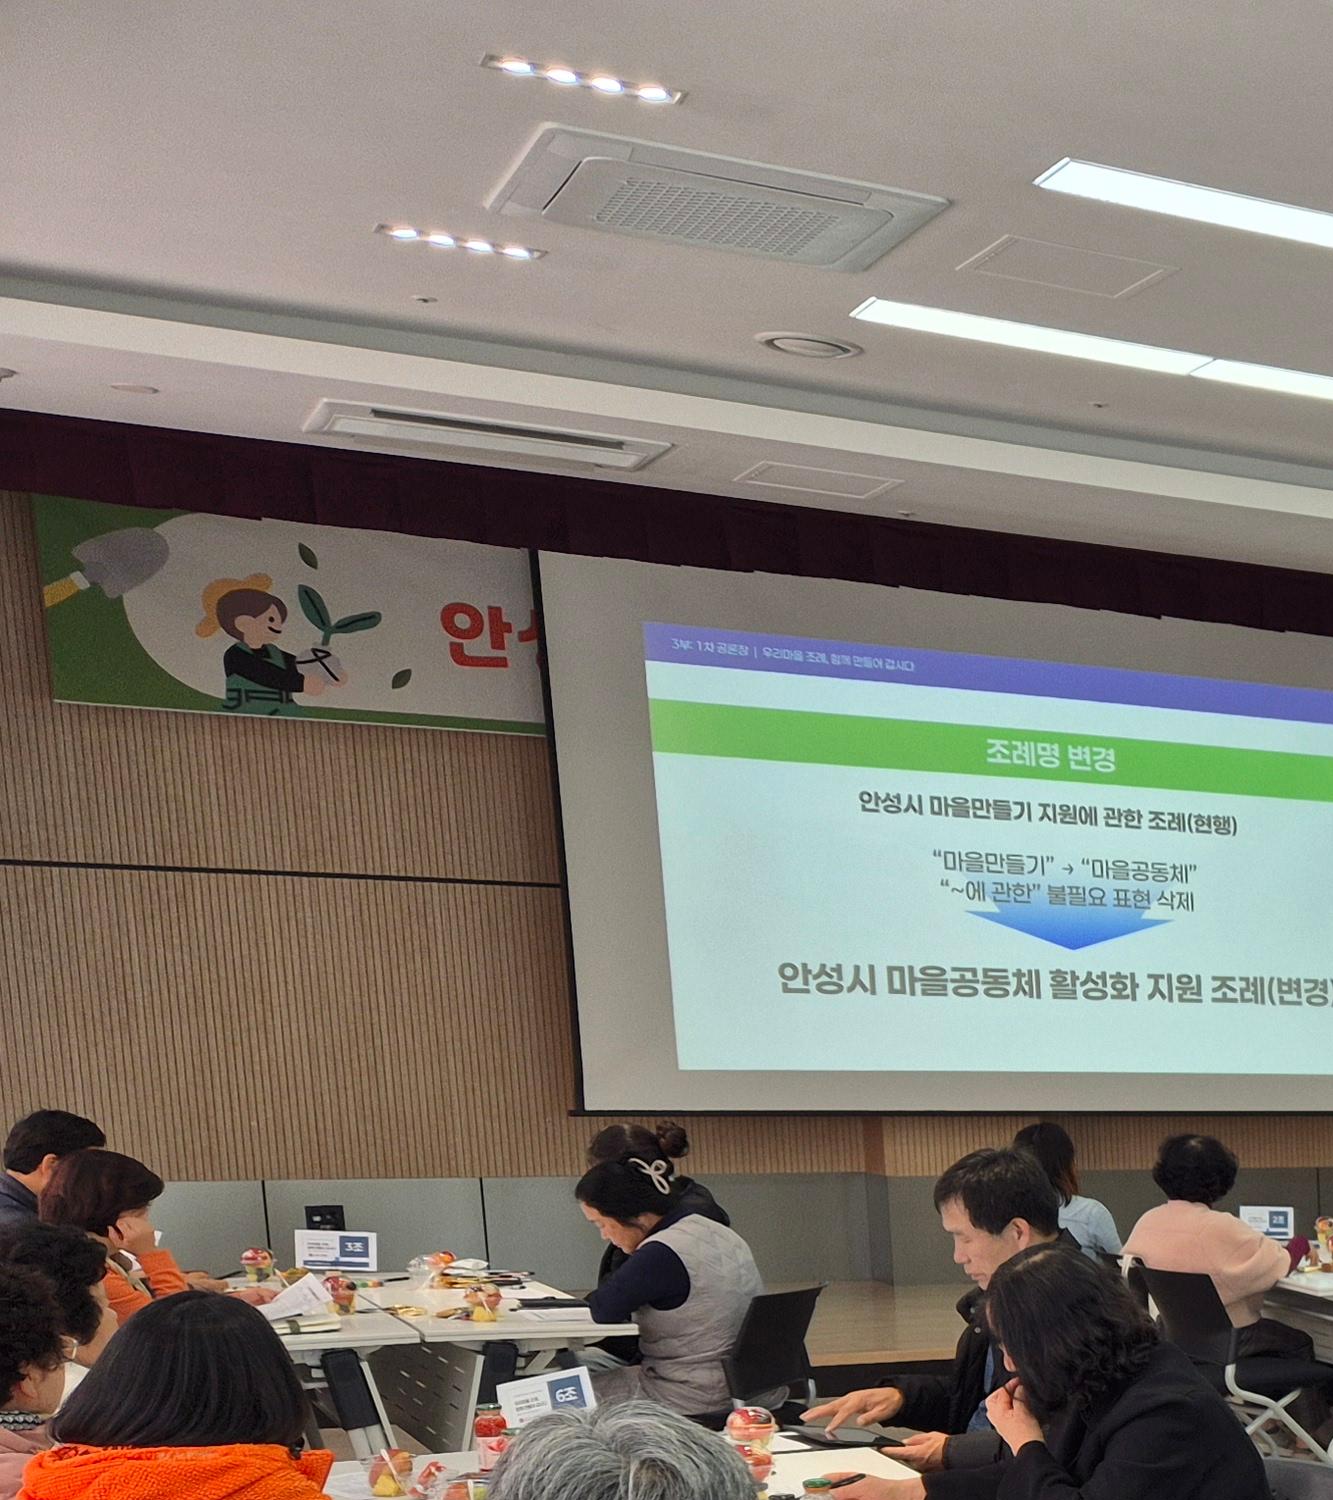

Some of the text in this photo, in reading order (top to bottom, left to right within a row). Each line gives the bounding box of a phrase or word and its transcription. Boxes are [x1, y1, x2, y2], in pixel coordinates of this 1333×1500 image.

[986, 738, 1116, 773] 조례명 변경
[858, 790, 1238, 837] 안성시 마을만들기 지원에 관한 조례(현행)
[1047, 883, 1106, 910] 불필요
[1112, 887, 1152, 911] 표현
[1157, 890, 1195, 913] 삭제
[778, 961, 877, 996] 안성시
[887, 964, 1042, 1000] 마을공동체
[1049, 968, 1139, 1002] 활성화
[1147, 973, 1203, 1004] 지원
[555, 1386, 579, 1402] 6조
